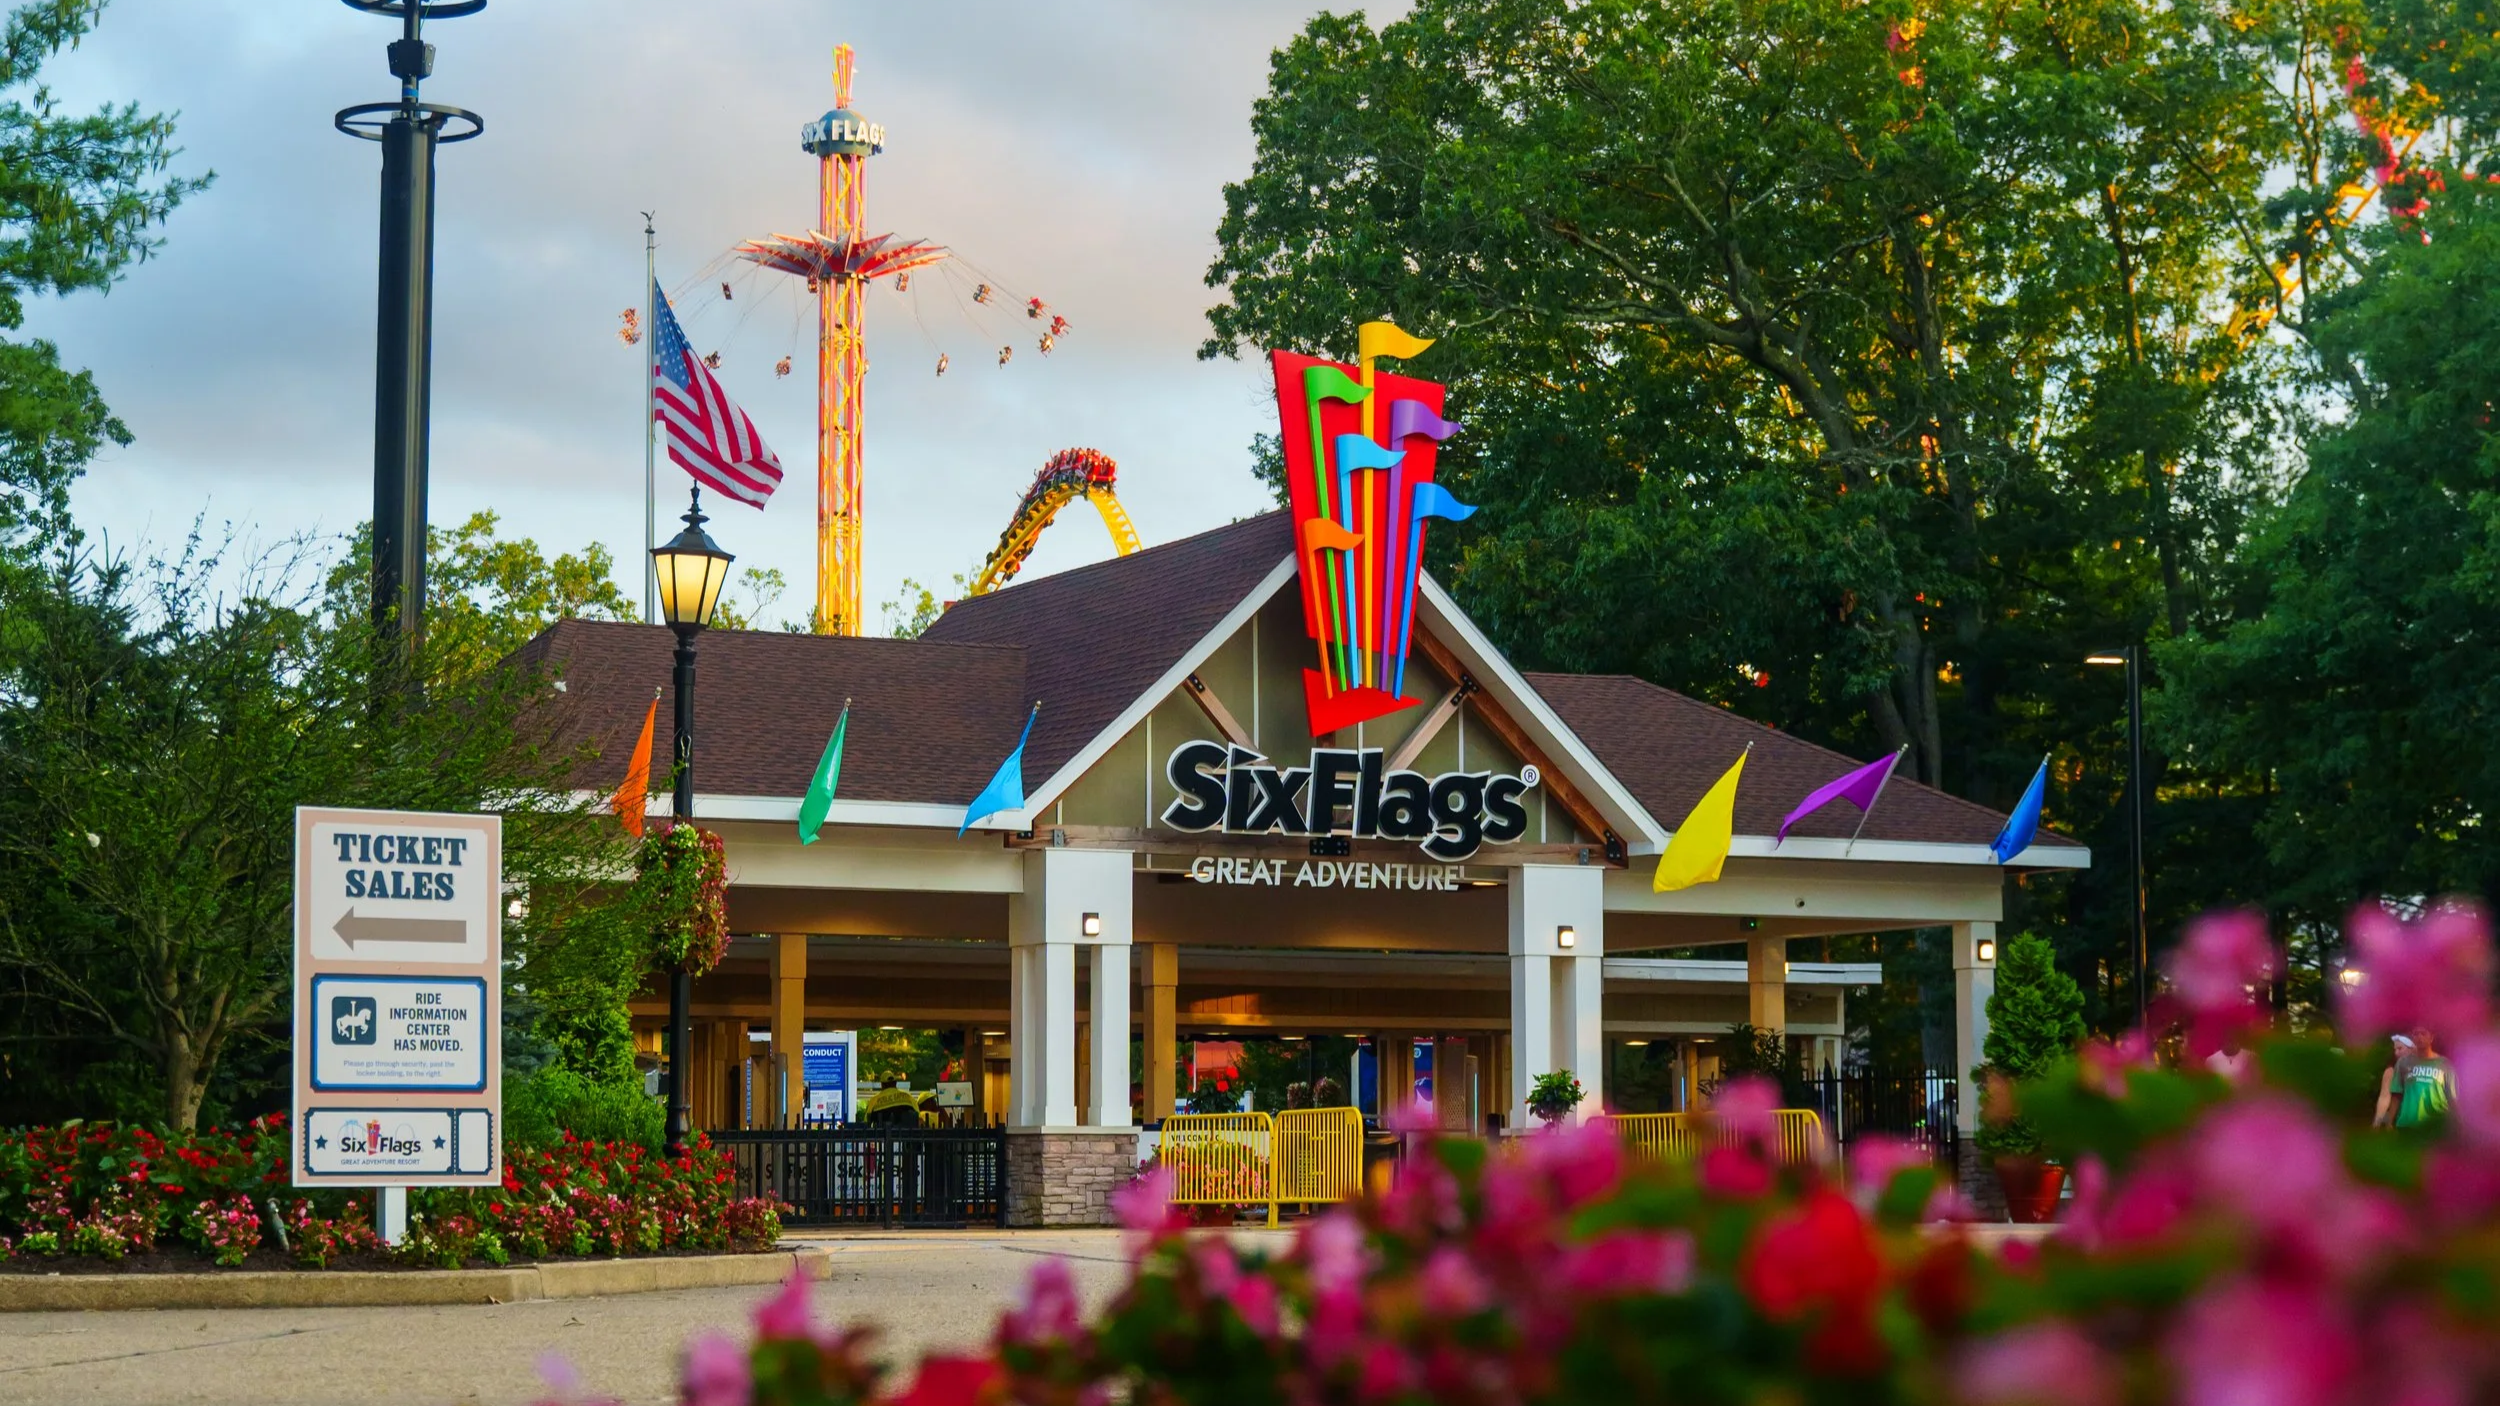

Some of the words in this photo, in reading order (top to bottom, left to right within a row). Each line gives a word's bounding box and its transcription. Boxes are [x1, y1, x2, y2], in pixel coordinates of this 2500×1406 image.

[801, 119, 828, 144] SIX
[831, 119, 885, 147] FLAGS
[333, 833, 467, 866] TICKET
[1192, 856, 1287, 886] GREAT
[1294, 861, 1461, 892] ADVENTURE
[345, 869, 455, 901] SALES
[415, 992, 442, 1005] RIDE
[389, 1008, 467, 1021] INFORMATION
[406, 1024, 451, 1036] CENTER
[394, 1039, 417, 1051] HAS
[420, 1039, 464, 1052] MOVED.
[803, 1048, 842, 1057] CONDUCT
[375, 1060, 400, 1068] through
[429, 1061, 443, 1069] past
[356, 1069, 376, 1077] locker
[2408, 1065, 2445, 1084] LONDON
[341, 1136, 366, 1153] Six
[380, 1136, 421, 1156] Flags
